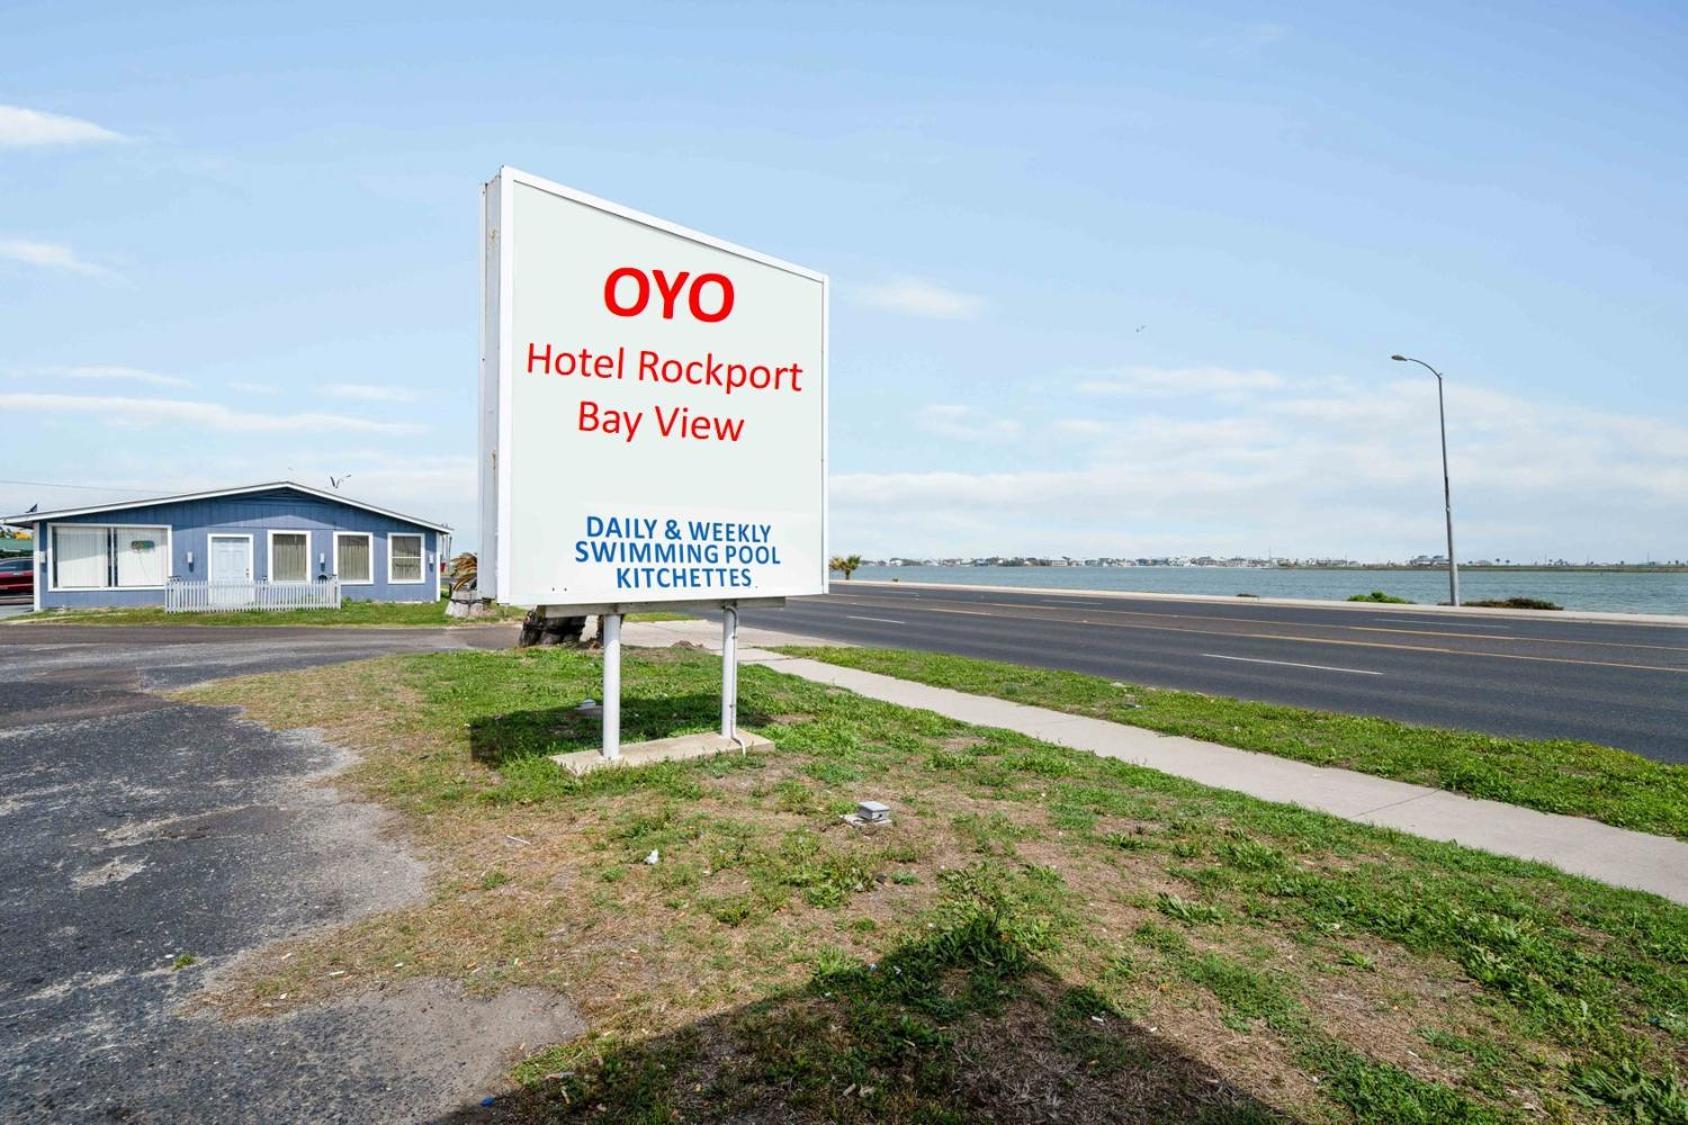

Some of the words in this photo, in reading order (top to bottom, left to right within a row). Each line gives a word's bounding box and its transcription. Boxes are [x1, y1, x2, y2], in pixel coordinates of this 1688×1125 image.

[603, 266, 735, 324] OYO
[527, 343, 625, 379] Hotel
[638, 350, 803, 395] Rockport
[578, 400, 643, 443] Bay
[654, 405, 745, 442] View
[586, 515, 658, 539] DAILY
[664, 519, 682, 541] &
[688, 521, 772, 543] WEEKLY
[575, 540, 719, 564] SWIMMING
[725, 545, 782, 565] POOL
[616, 567, 753, 589] KITCHETTES
